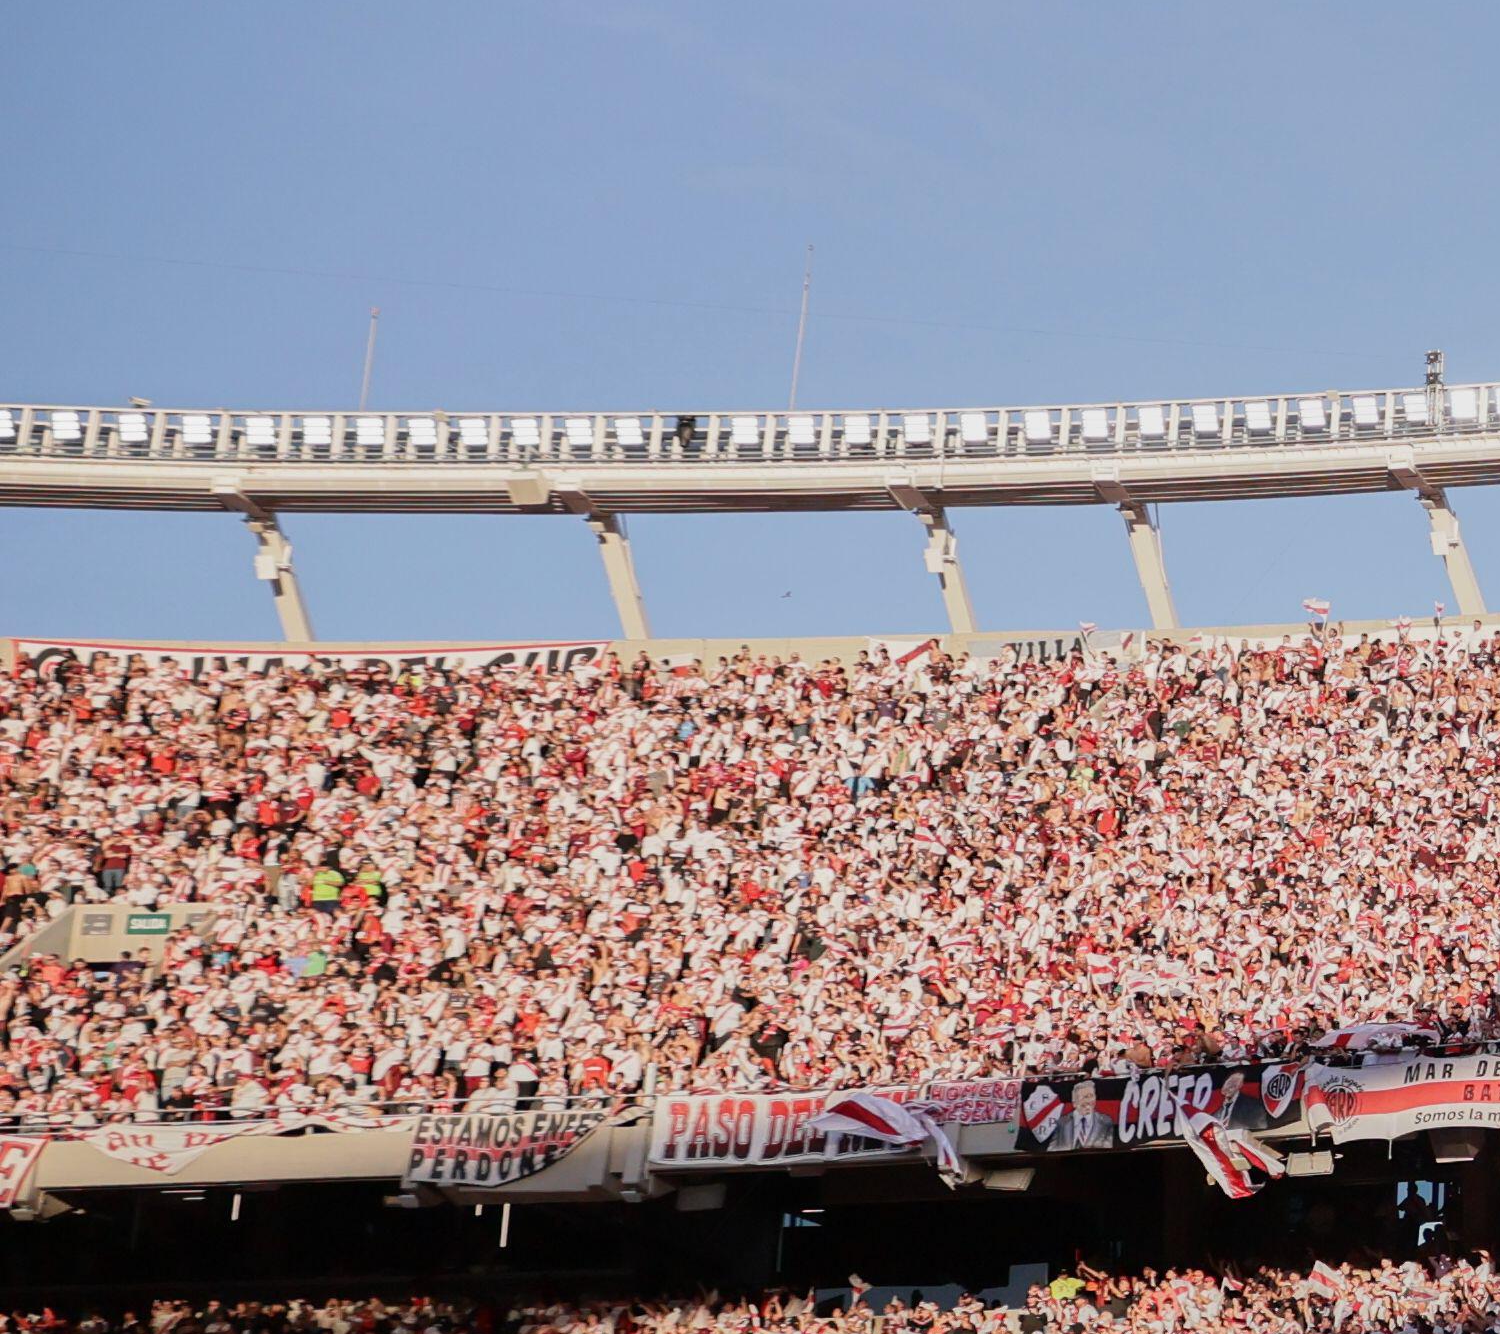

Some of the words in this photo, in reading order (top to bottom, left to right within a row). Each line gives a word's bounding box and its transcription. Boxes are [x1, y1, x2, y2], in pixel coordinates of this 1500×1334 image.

[1403, 1063, 1454, 1084] MAR
[1414, 1111, 1466, 1124] Somos
[1469, 1109, 1484, 1121] la
[416, 1117, 522, 1147] ESTAMOS
[665, 1101, 754, 1160] PASO
